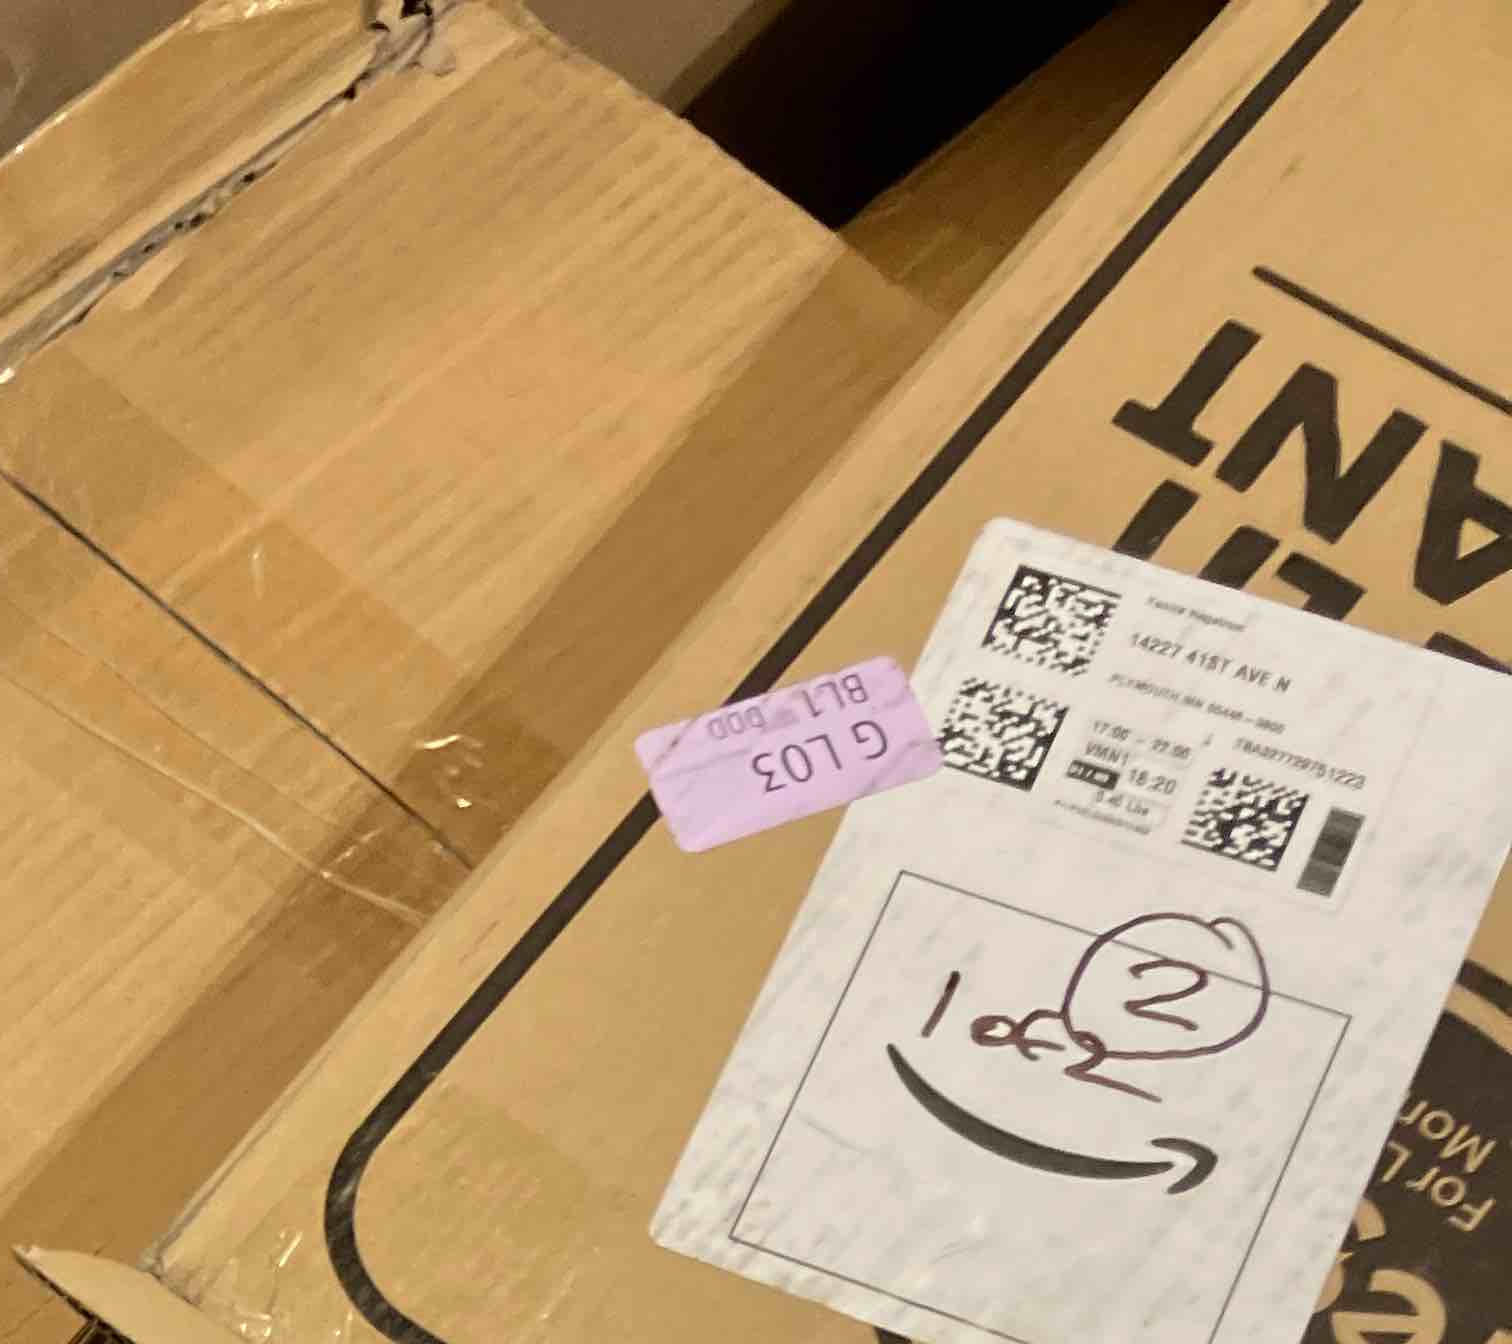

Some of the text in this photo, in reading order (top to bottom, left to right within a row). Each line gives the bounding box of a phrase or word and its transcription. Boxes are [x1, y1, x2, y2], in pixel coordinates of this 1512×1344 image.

[1131, 633, 1291, 692] 14227 41ST AVE N
[1124, 959, 1207, 1031] 2
[1407, 1166, 1494, 1232] For
